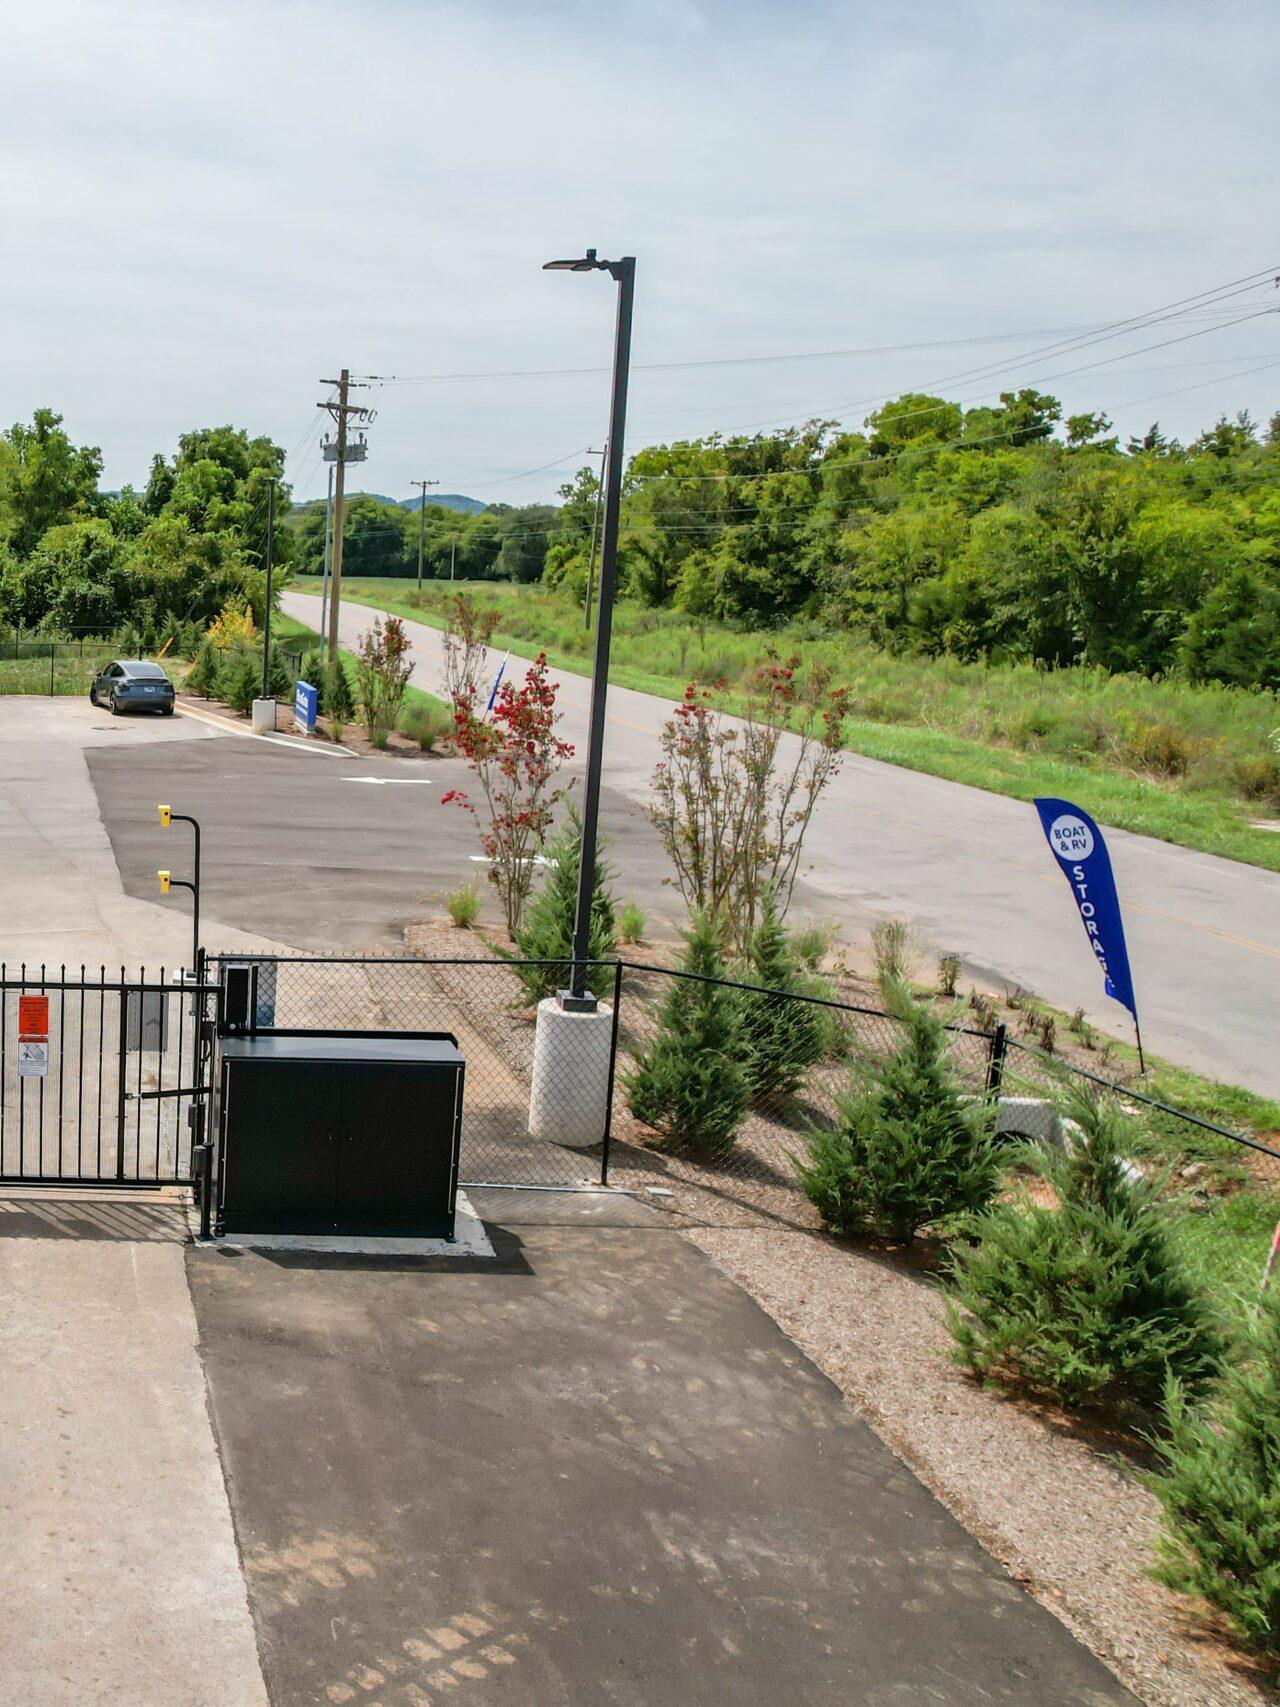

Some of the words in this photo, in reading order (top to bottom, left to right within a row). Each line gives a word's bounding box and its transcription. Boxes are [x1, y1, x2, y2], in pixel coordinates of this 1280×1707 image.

[1054, 825, 1086, 840] BOAT
[1060, 840, 1069, 852] &
[1071, 839, 1087, 850] RV
[1073, 865, 1115, 989] STORAG
